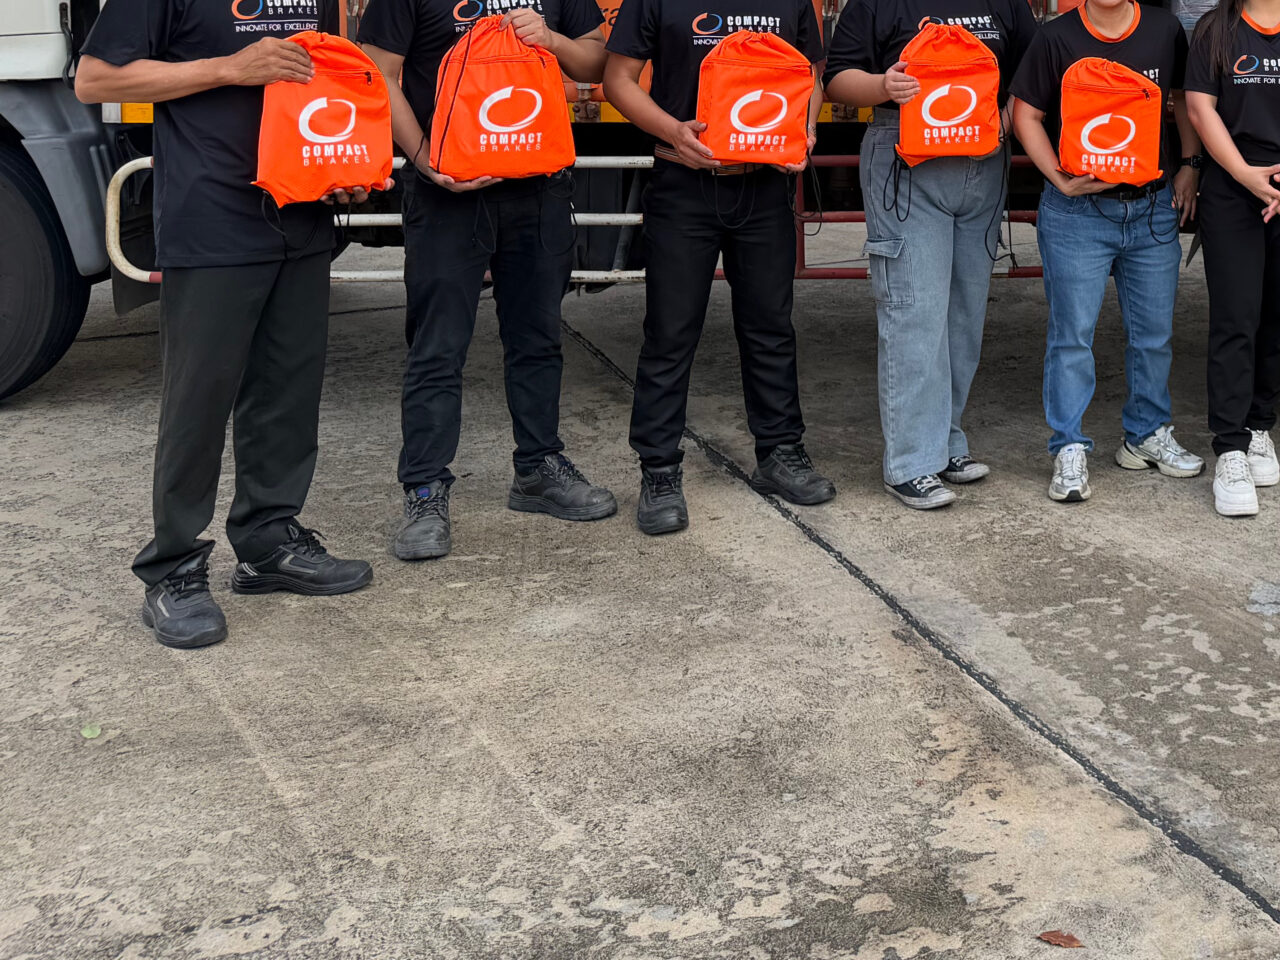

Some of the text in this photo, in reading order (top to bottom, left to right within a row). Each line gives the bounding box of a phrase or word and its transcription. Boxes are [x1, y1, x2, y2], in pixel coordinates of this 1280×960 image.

[268, 7, 318, 15] BRAKES
[726, 15, 781, 27] COMPACT
[947, 15, 992, 26] COMPAC
[235, 22, 318, 32] INNOVATE FOR EXCELLENCE
[1233, 77, 1261, 85] INNOVATE
[924, 125, 980, 138] COMPACT
[479, 132, 542, 145] COMPACT
[729, 133, 787, 145] COMPACT
[924, 136, 980, 146] BRAKES
[302, 144, 368, 158] COMPACT
[480, 143, 542, 153] BRAKES
[729, 144, 785, 153] BRAKES
[303, 156, 371, 167] BRAKES
[1081, 154, 1136, 167] COMPACT
